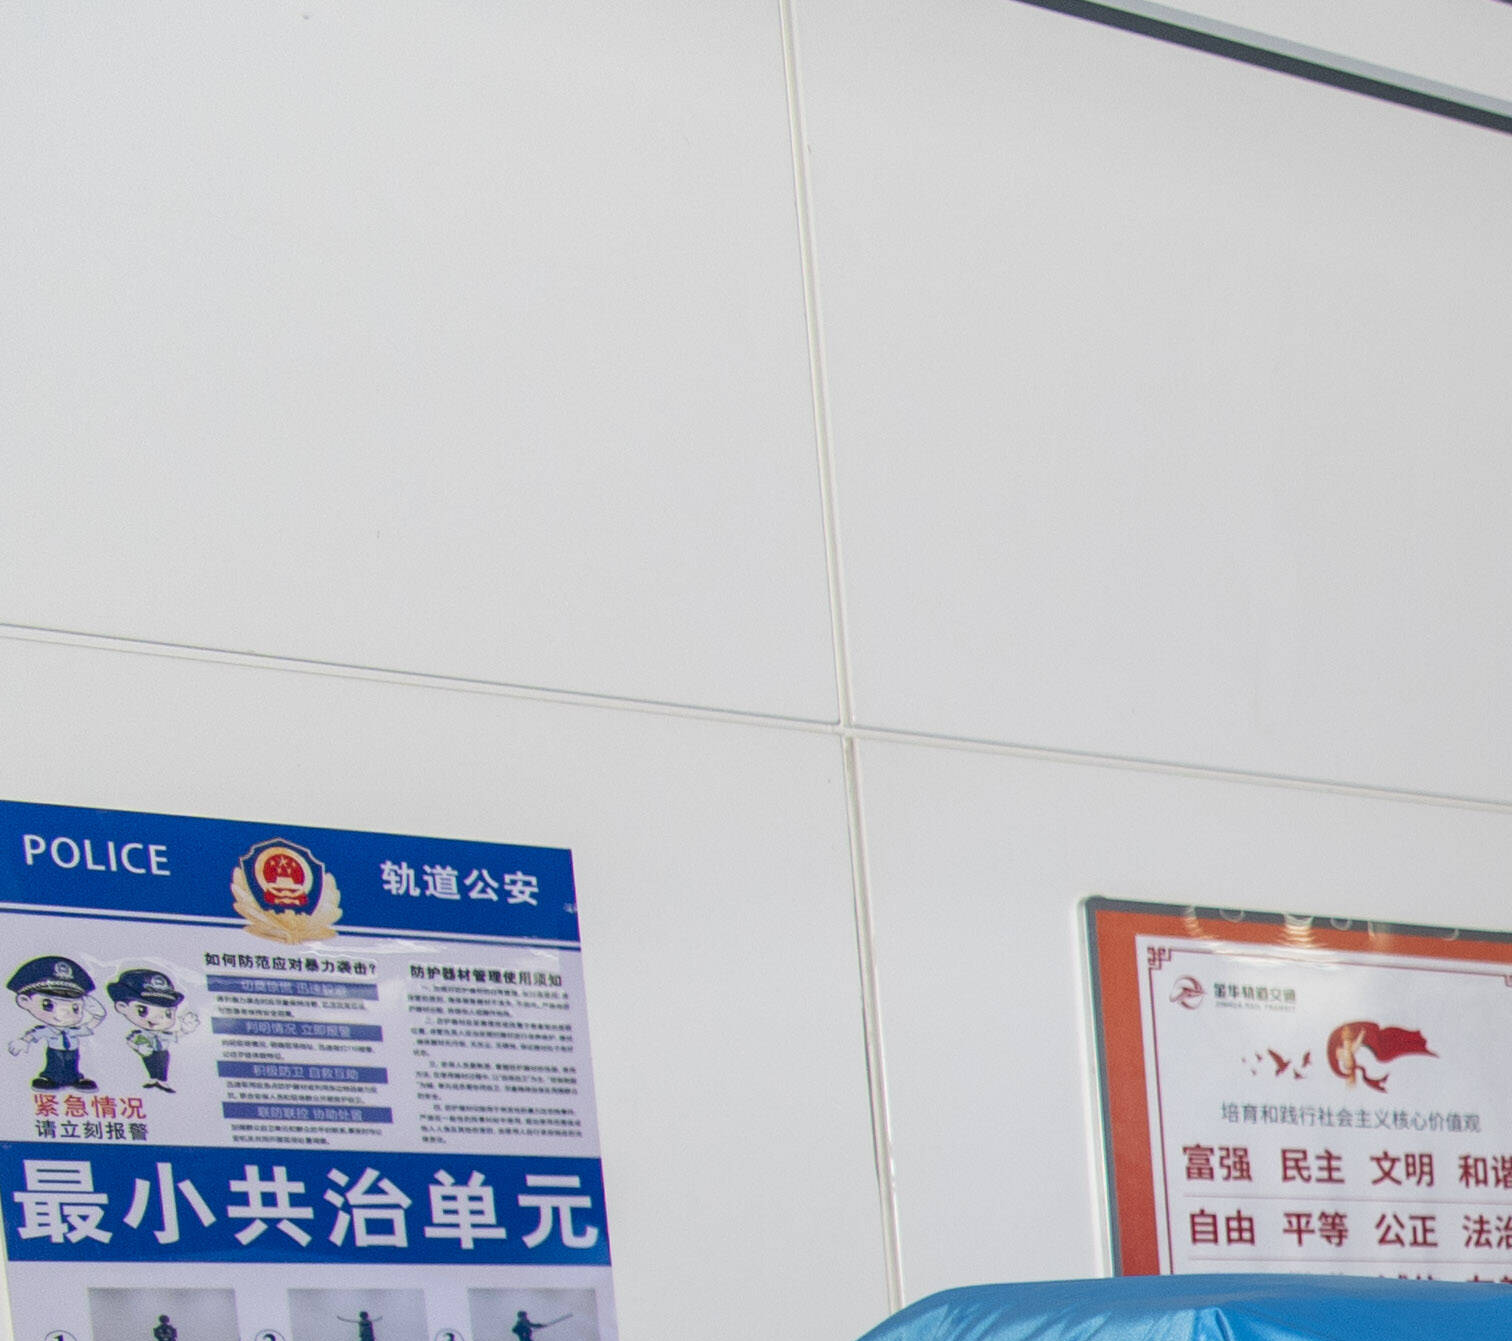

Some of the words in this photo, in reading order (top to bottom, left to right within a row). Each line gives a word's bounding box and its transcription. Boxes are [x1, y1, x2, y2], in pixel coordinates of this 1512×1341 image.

[22, 834, 171, 877] POLICE
[381, 861, 540, 907] 轨道公安
[33, 1094, 147, 1120] 紧急情况
[1221, 1102, 1481, 1134] 培育和践行社会主义核心价值观
[34, 1120, 149, 1143] 请立刻报警
[1182, 1145, 1253, 1183] 富强
[1280, 1148, 1345, 1185] 民主
[1370, 1151, 1435, 1187] 文明
[13, 1159, 599, 1252] 最小共治单元
[1188, 1208, 1256, 1246] 自由
[1282, 1211, 1349, 1248] 平等
[1375, 1213, 1438, 1248] 公正
